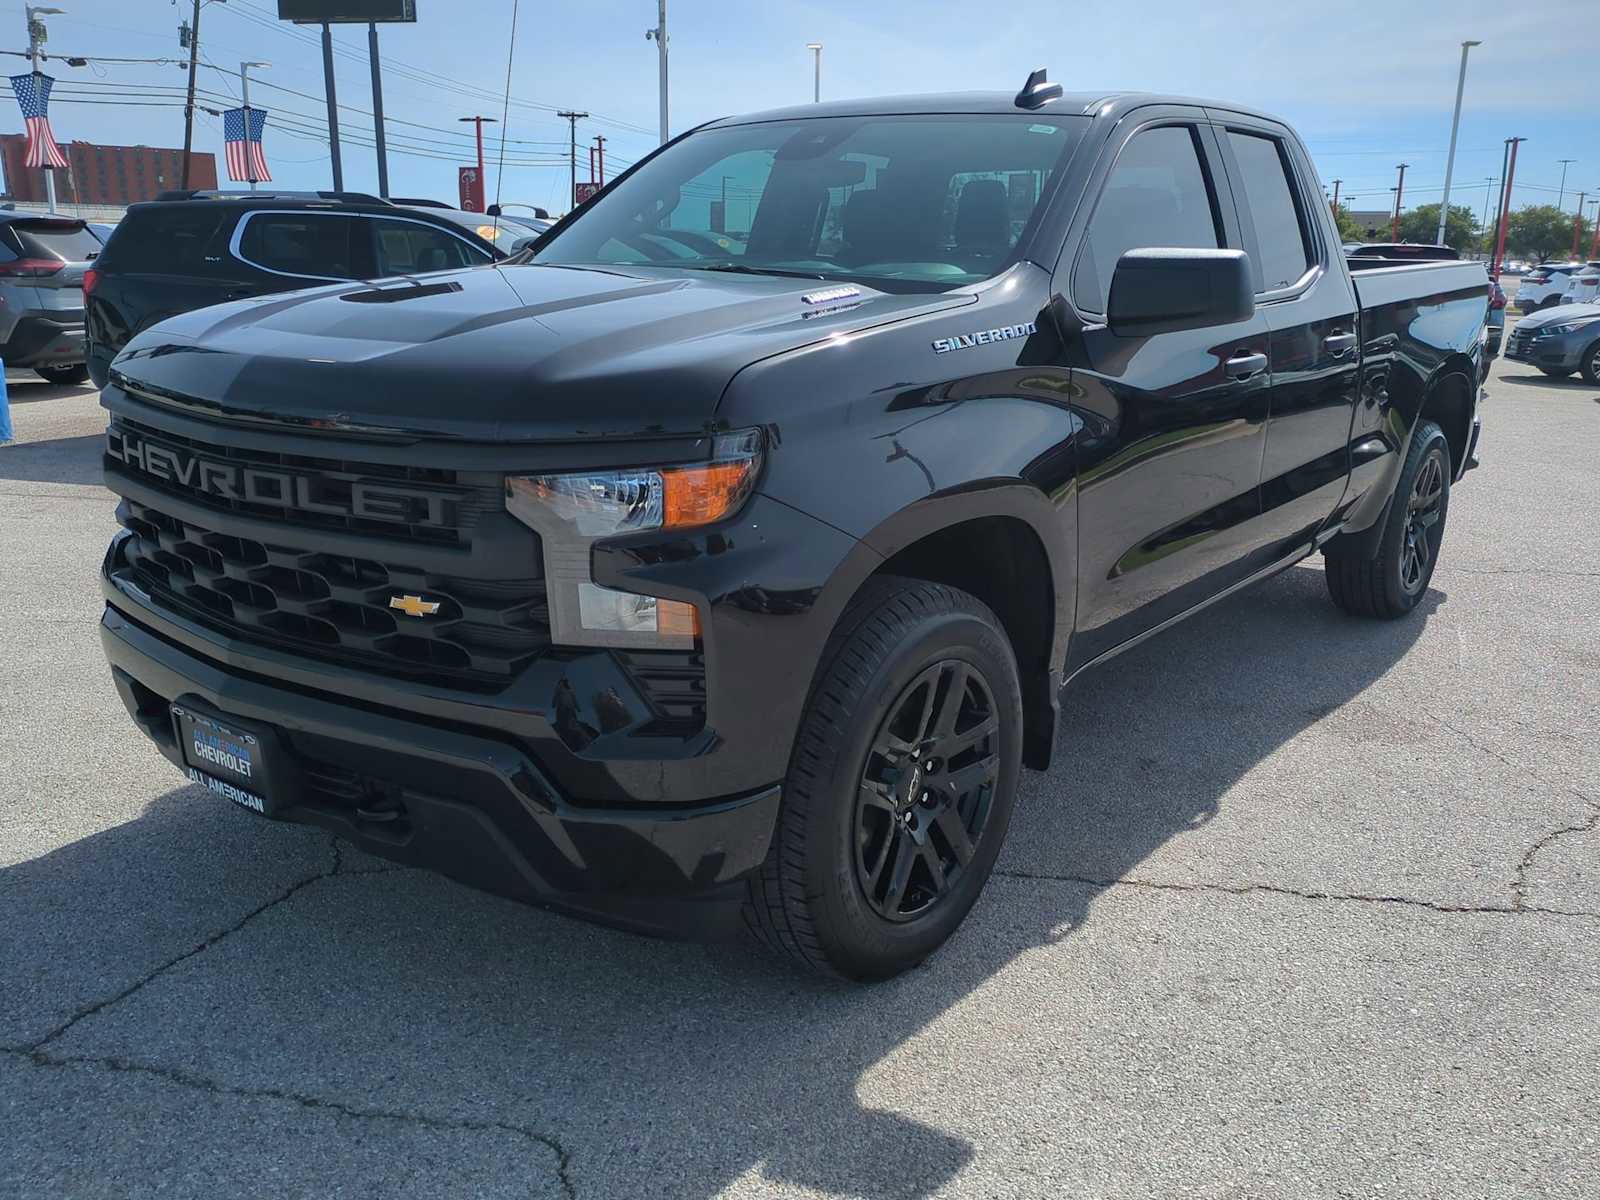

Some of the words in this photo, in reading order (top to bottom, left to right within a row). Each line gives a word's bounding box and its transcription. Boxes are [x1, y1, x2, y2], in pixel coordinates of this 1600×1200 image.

[933, 322, 1037, 354] SILVERADO
[106, 430, 468, 526] CHEVROLET
[194, 741, 252, 777] CHEVROLET
[189, 767, 208, 787] ALL
[208, 777, 264, 813] AMERICAN
